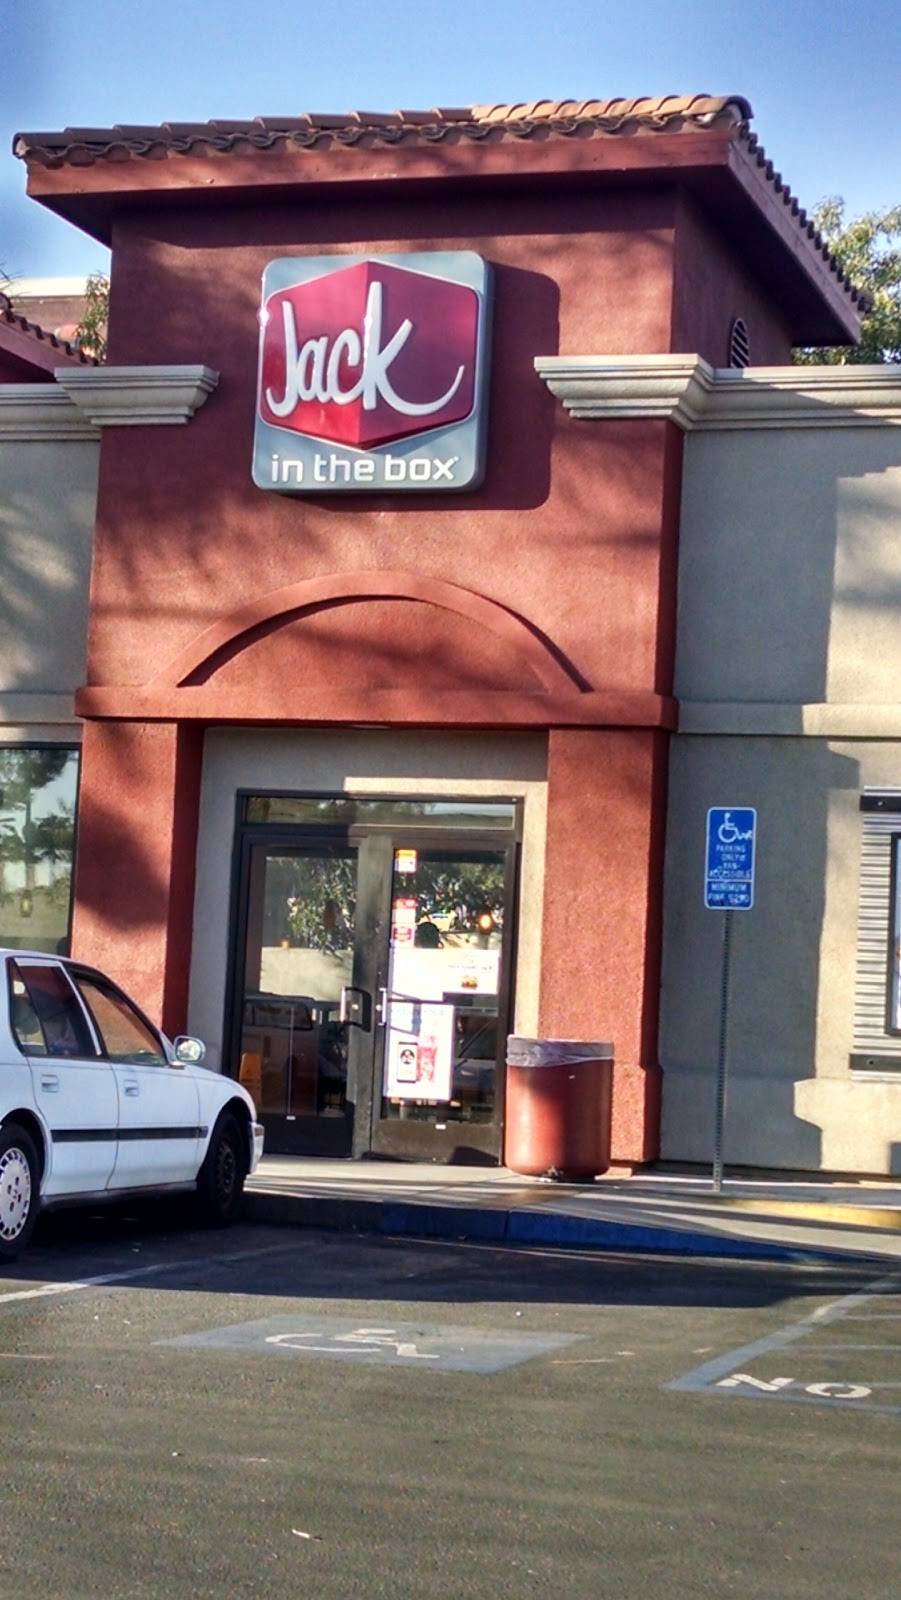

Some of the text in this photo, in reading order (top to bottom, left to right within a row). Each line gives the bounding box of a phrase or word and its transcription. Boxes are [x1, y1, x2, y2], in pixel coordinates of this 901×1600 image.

[266, 281, 465, 417] Jack
[271, 454, 456, 482] in the box
[716, 844, 746, 853] PARKING
[711, 883, 747, 891] MINIMUM
[715, 1373, 872, 1398] NO
